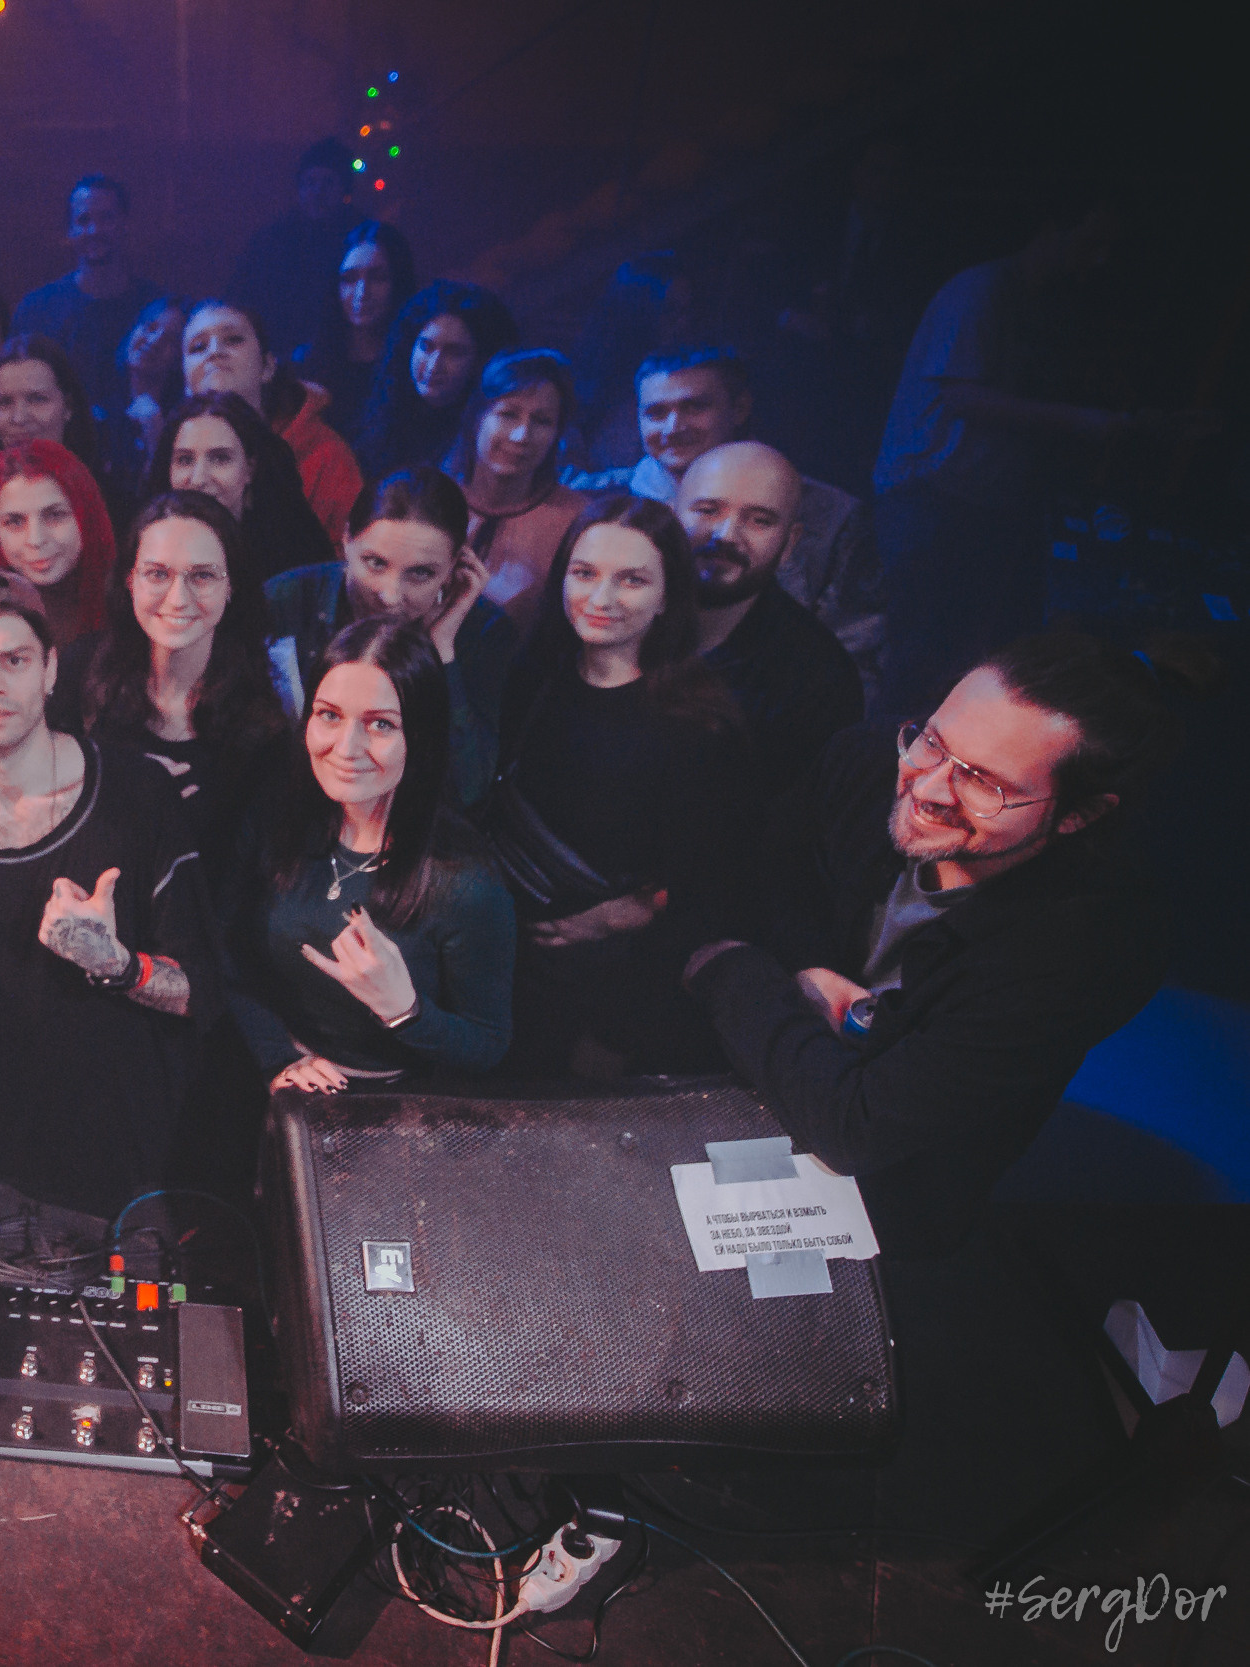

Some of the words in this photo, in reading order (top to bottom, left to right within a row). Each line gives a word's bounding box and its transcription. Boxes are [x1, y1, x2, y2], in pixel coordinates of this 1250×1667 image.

[712, 1213, 739, 1224] ЧТОБЫ
[740, 1209, 786, 1222] ВЫРВАТЬСЯ
[793, 1206, 827, 1217] ВЗМЫТЬ
[710, 1229, 721, 1240] ЗА
[745, 1226, 756, 1237] ЗА
[756, 1222, 792, 1236] ЗВЕЗДОЙ
[714, 1243, 725, 1255] ЕЙ
[726, 1243, 748, 1254] НАДО
[748, 1241, 772, 1252] БЫЛО
[772, 1239, 802, 1250] ТОЛЬКО
[803, 1237, 826, 1248] БЫТЬ
[826, 1232, 853, 1245] СОБОЙ
